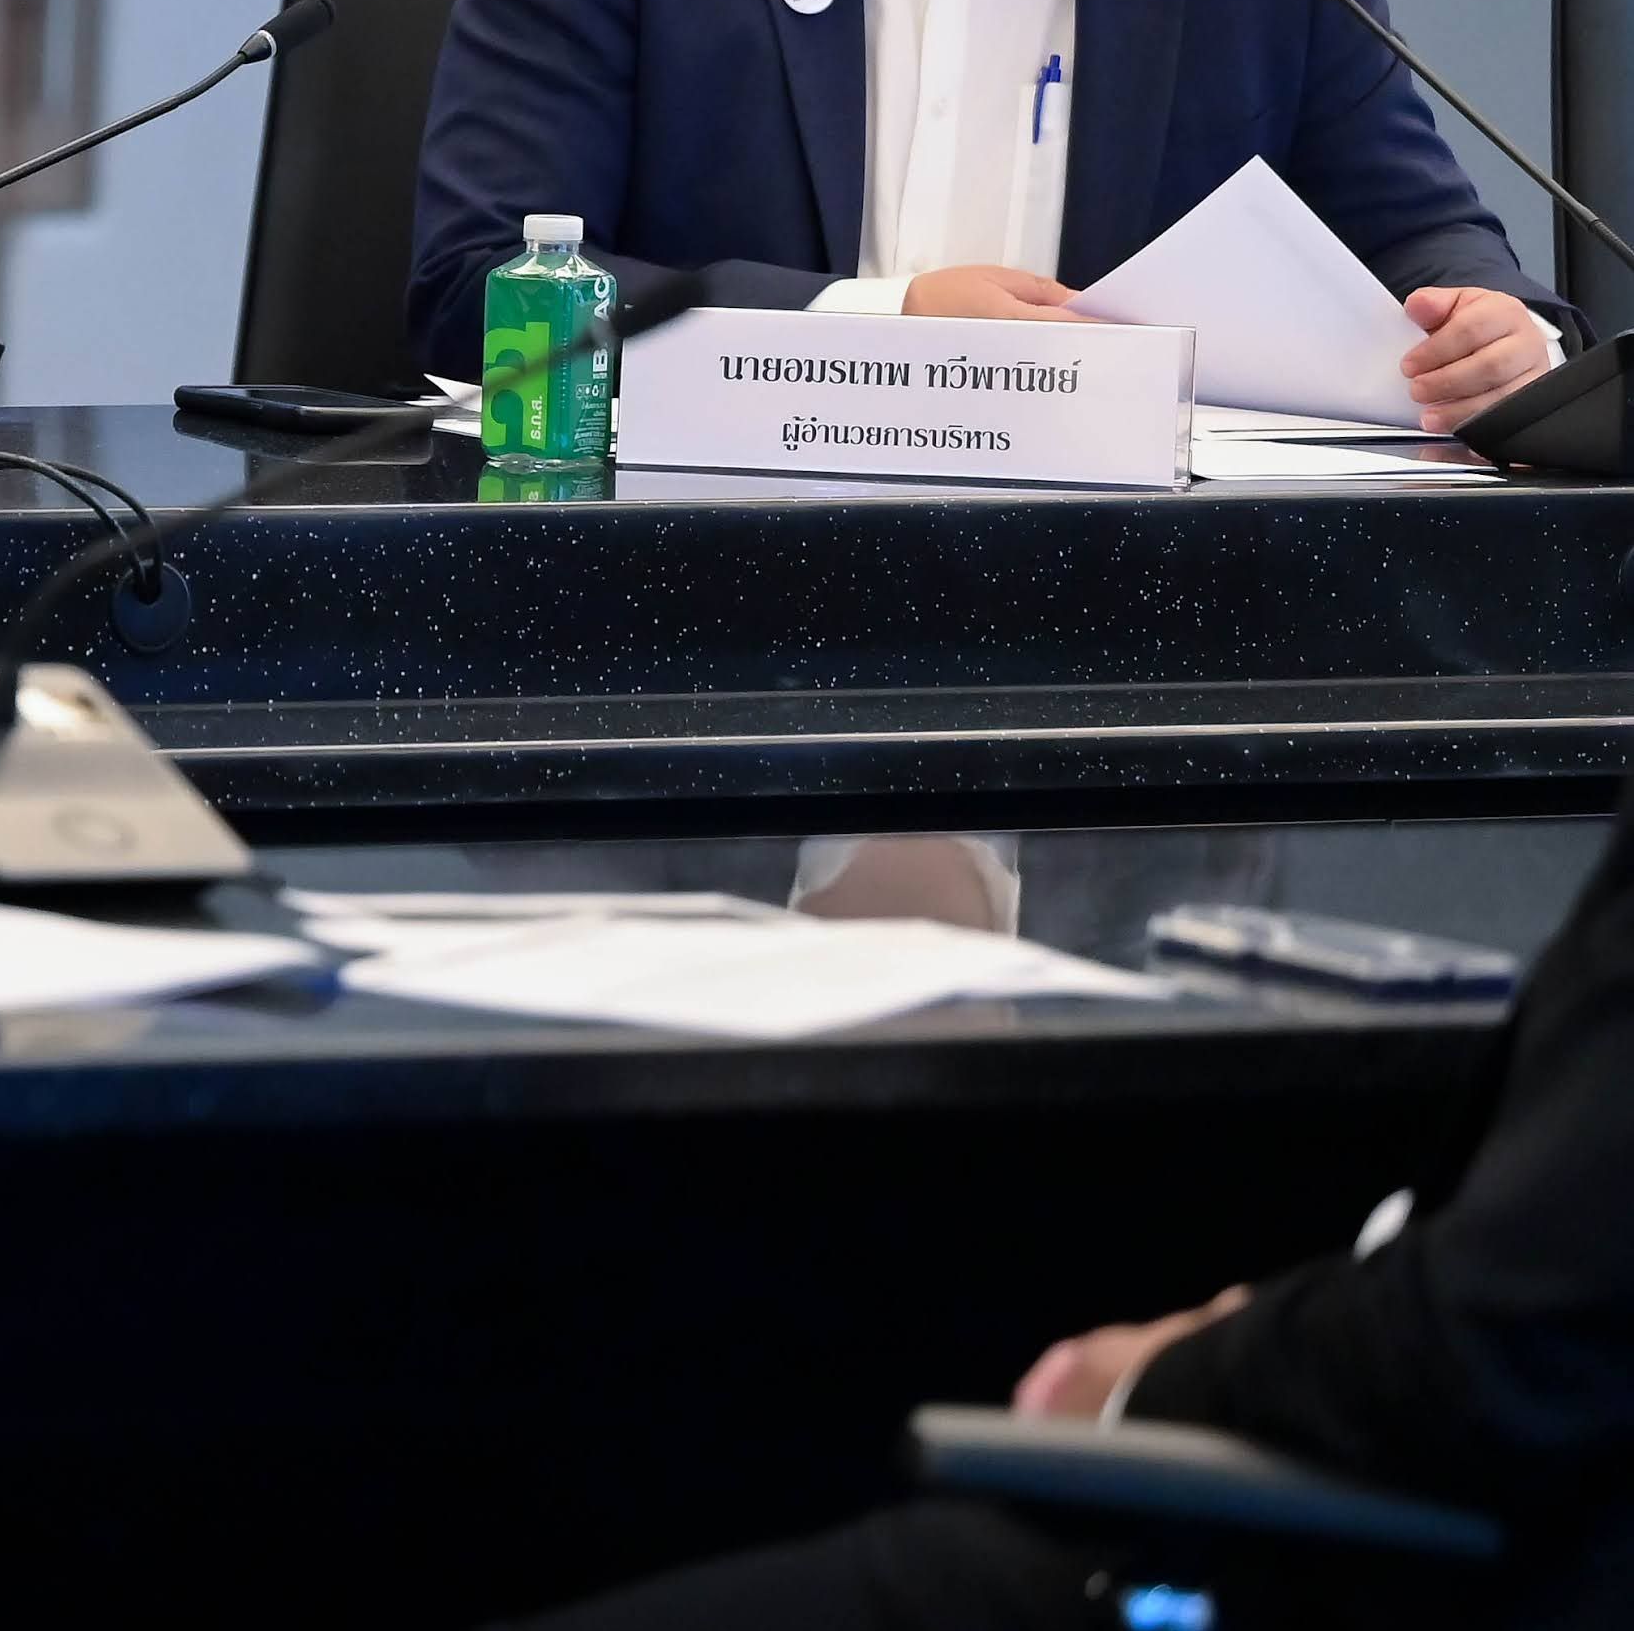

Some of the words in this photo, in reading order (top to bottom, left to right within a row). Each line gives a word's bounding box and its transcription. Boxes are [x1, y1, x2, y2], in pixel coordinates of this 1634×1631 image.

[593, 277, 610, 372] BAC
[719, 355, 910, 387] นายอมรเทพ
[924, 355, 1082, 394] ทวีพานิชย์
[531, 396, 543, 440] ธ.ก.ส.
[782, 416, 1011, 451] ผู้อำนวยการบริหาร
